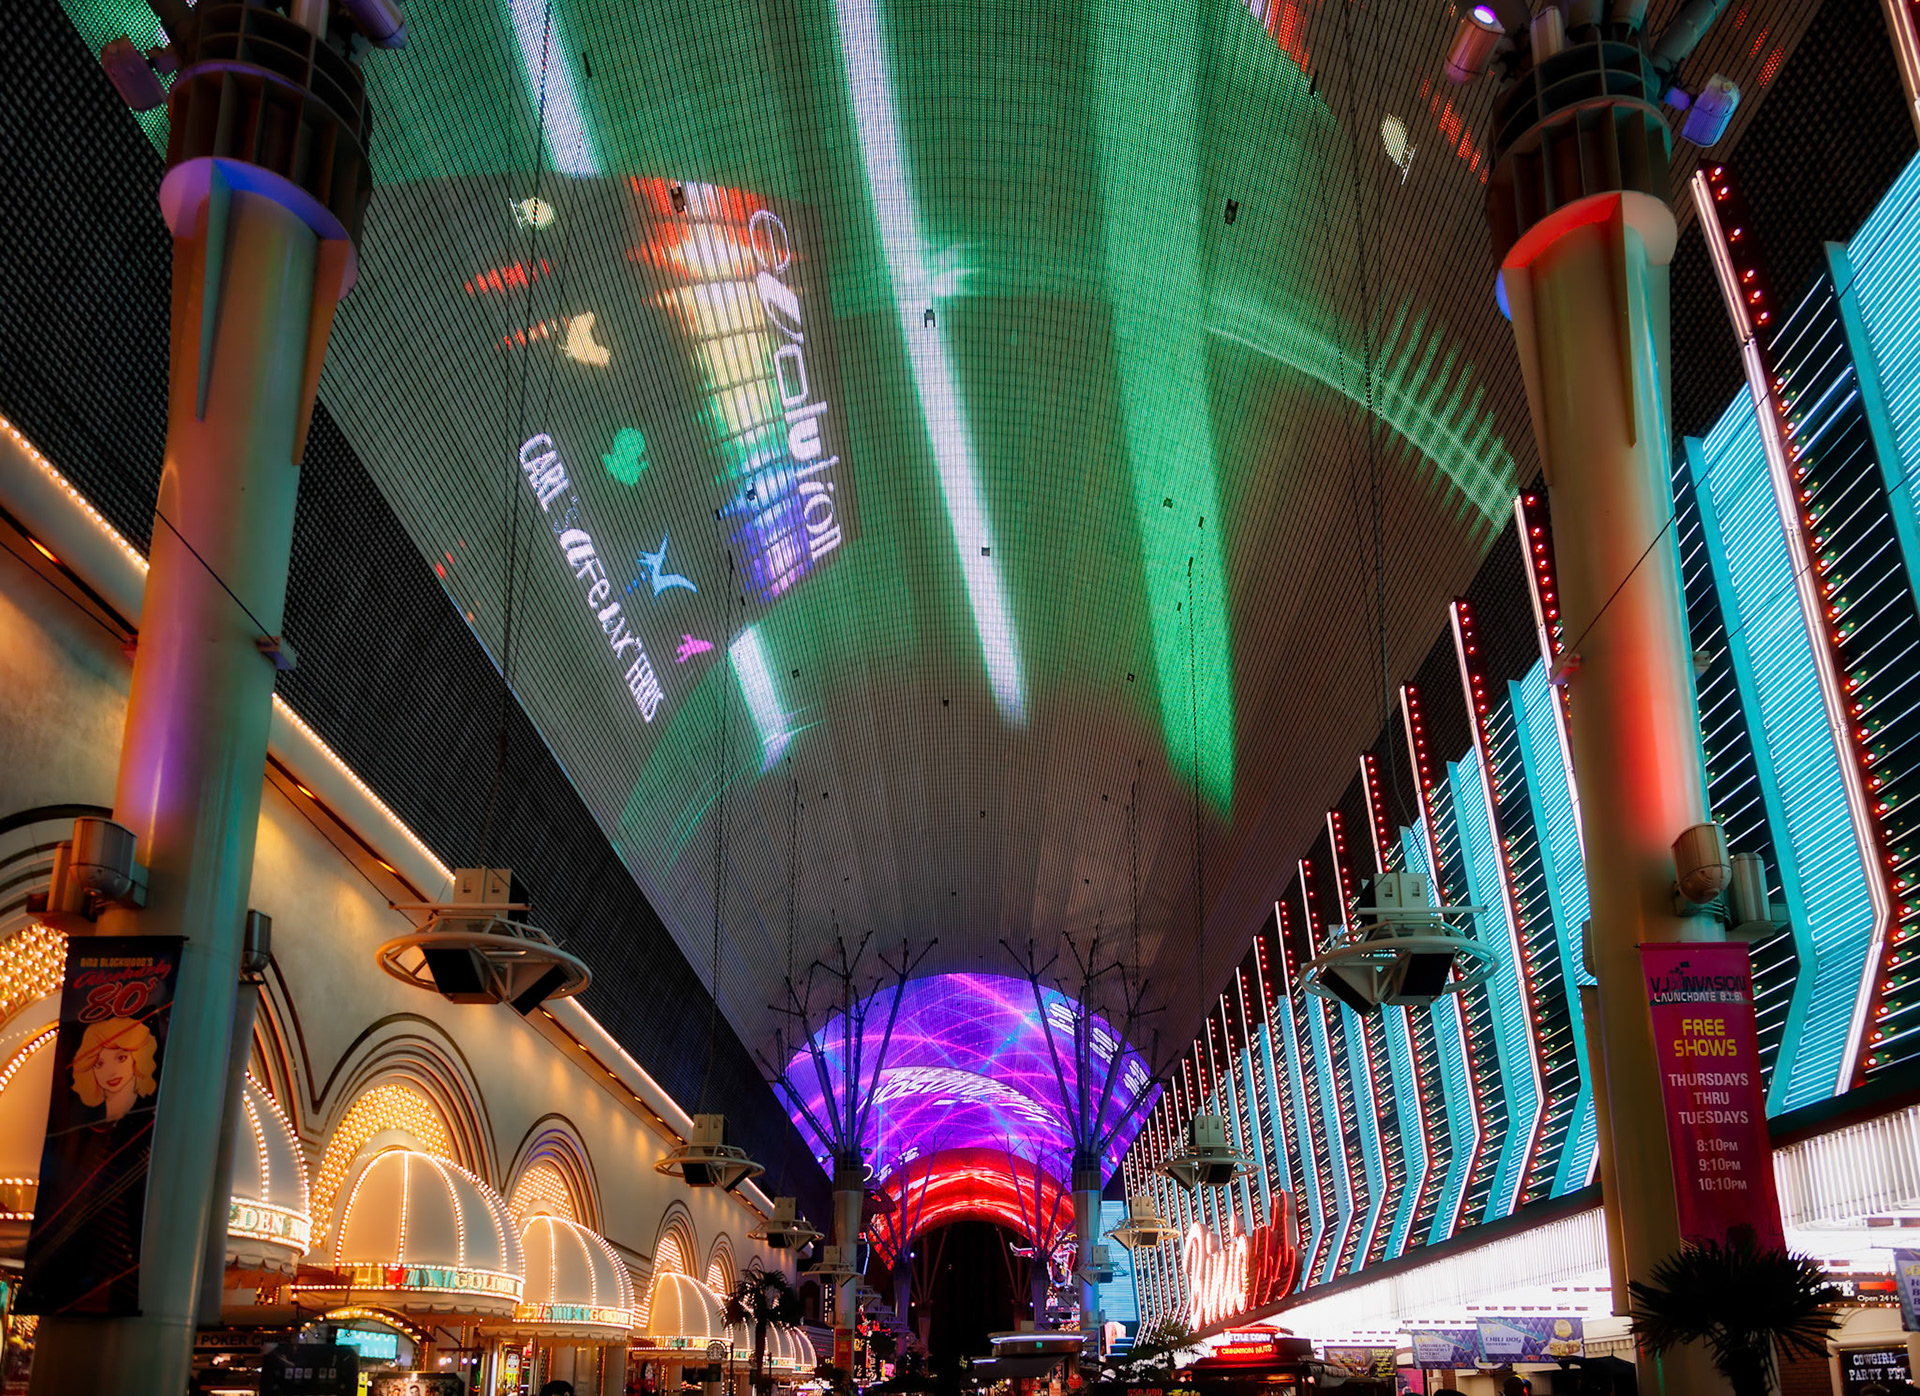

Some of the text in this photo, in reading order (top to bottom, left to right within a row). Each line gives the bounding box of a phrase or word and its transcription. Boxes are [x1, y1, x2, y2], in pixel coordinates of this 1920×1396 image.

[518, 432, 570, 513] CARL
[624, 650, 665, 723] FERRIS
[1654, 991, 1717, 1003] LAUNCHDATE
[1682, 1018, 1726, 1036] FREE
[1673, 1038, 1738, 1057] SHOWS
[1668, 1073, 1750, 1087] THURSDAYS
[1693, 1091, 1730, 1105] THRU
[1678, 1111, 1749, 1125] TUESDAYS
[1696, 1138, 1739, 1152] 8:10PM
[1698, 1158, 1742, 1172] 9:10PM
[1698, 1177, 1748, 1191] 10:10PM
[1857, 1294, 1878, 1303] Open
[1880, 1294, 1889, 1302] 24
[201, 1334, 248, 1346] POKER
[1255, 1344, 1273, 1354] NUTS
[1853, 1352, 1896, 1365] COWGIRL
[1848, 1368, 1882, 1381] PARTY
